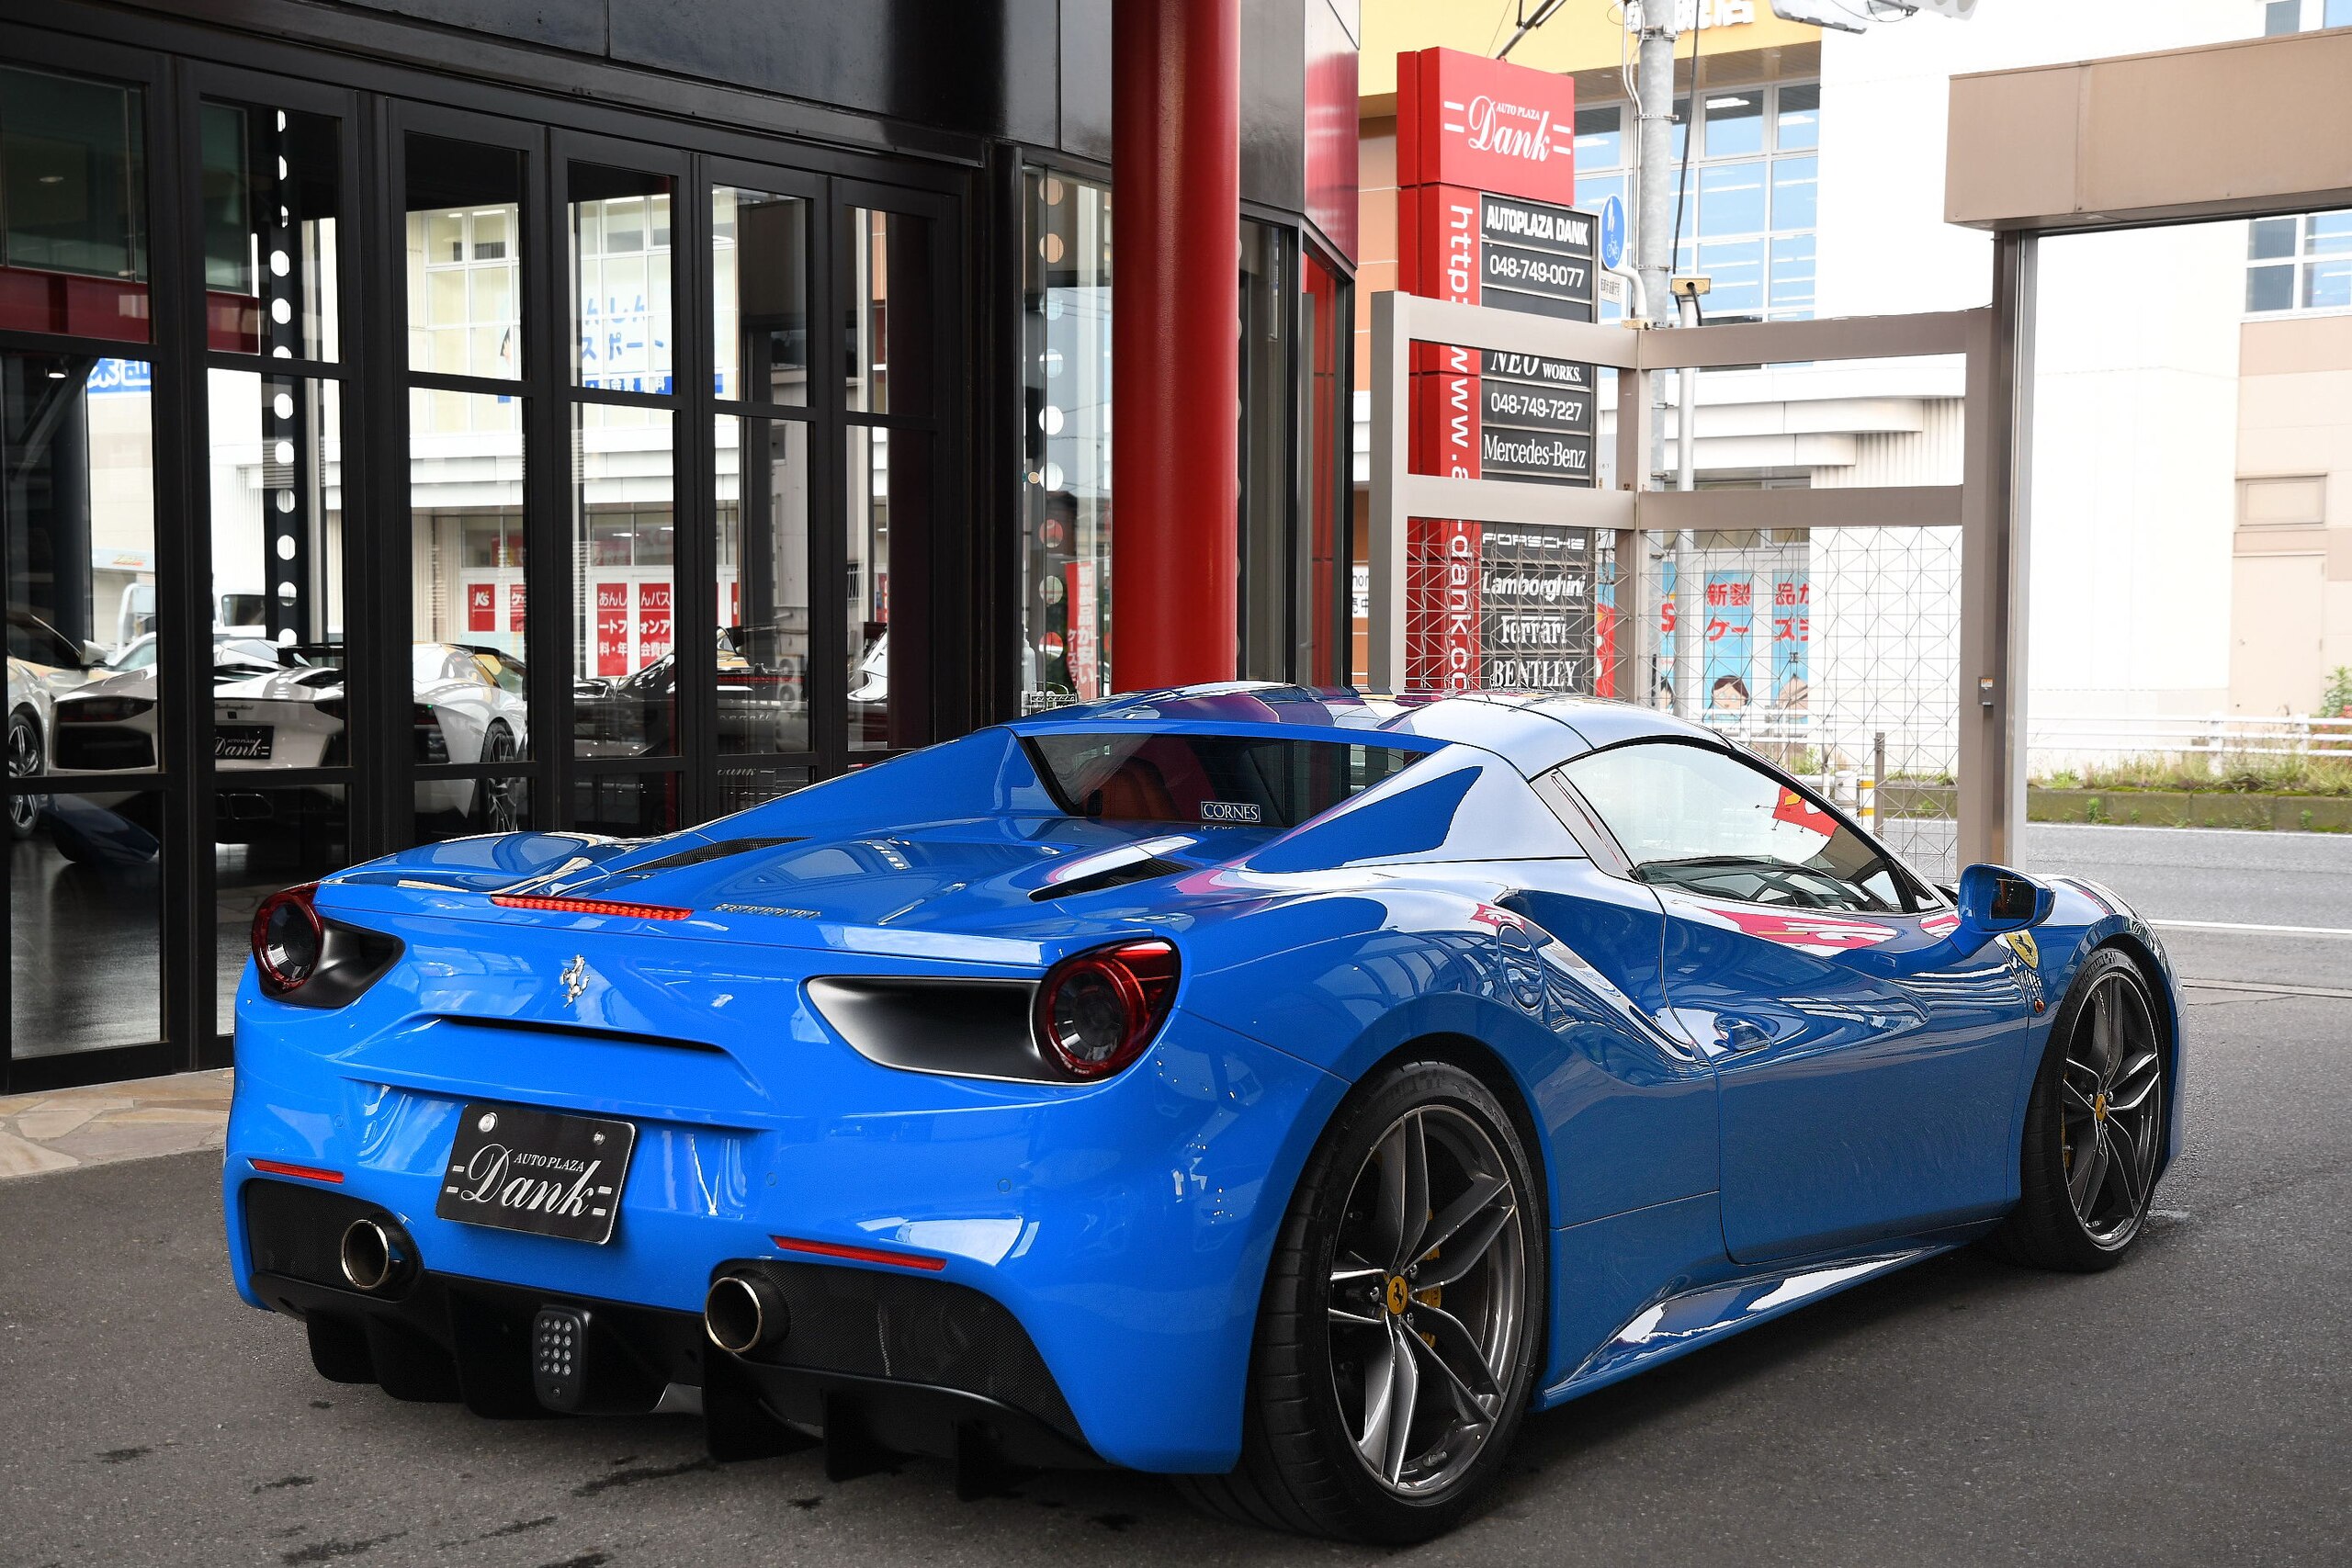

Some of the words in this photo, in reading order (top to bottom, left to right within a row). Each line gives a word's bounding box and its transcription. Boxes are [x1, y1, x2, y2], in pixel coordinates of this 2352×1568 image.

[1497, 103, 1517, 116] AUTO
[1517, 107, 1540, 120] PLAZA
[1468, 96, 1550, 162] Dank
[1486, 205, 1555, 241] AUTOPLAZA
[1556, 218, 1589, 246] DANK
[1489, 254, 1585, 288] 048-749-0077
[1490, 392, 1583, 422] 048-749-7227
[1483, 434, 1587, 469] Mercedes-Benz
[1482, 532, 1586, 550] PORSCHE
[1482, 570, 1587, 602] Lamborghini
[1501, 615, 1566, 644] Ferrari
[1490, 660, 1577, 687] BENTLEY
[1203, 803, 1258, 820] CORNES
[514, 1152, 547, 1167] AUTO
[547, 1156, 585, 1173] PLAZA
[460, 1143, 602, 1217] Dank
